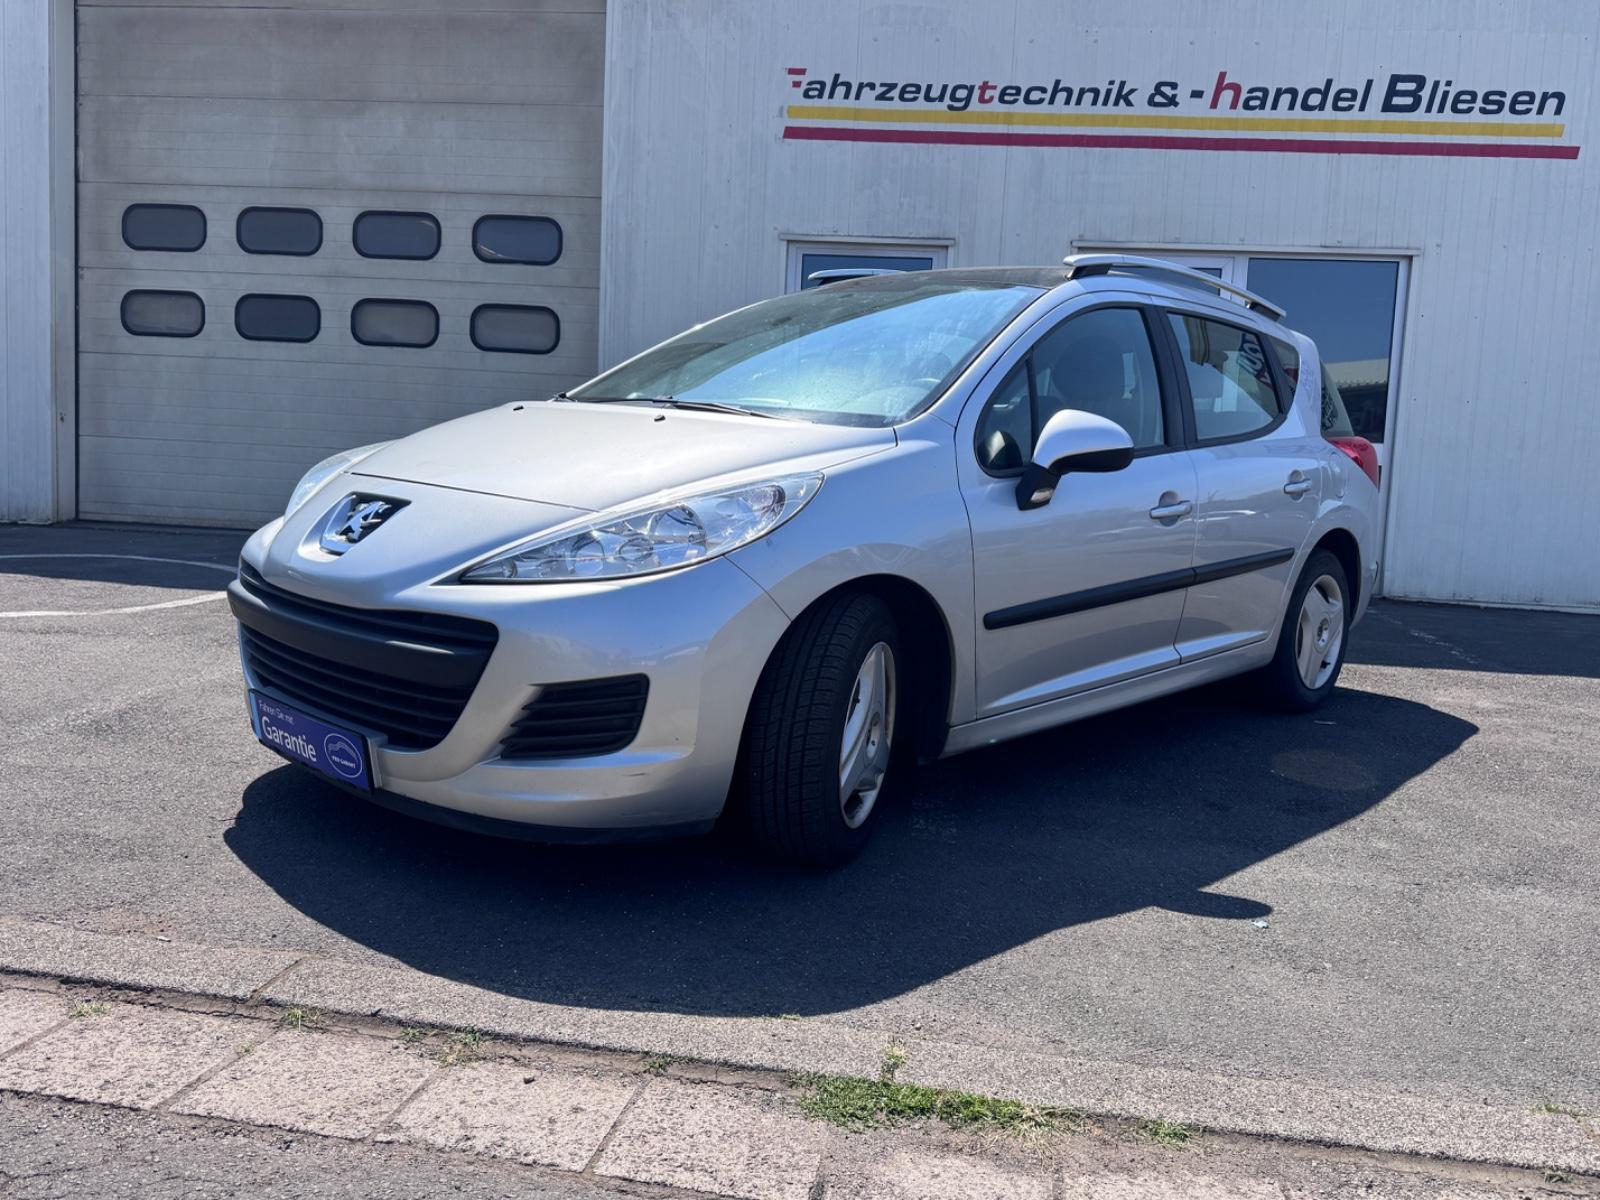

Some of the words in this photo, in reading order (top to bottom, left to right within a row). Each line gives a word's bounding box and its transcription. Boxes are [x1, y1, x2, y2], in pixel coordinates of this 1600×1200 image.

[785, 67, 1138, 112] Fahrzeugtechnik
[1147, 81, 1180, 109] &
[1380, 73, 1567, 116] Bliesen
[261, 715, 317, 762] Garantie
